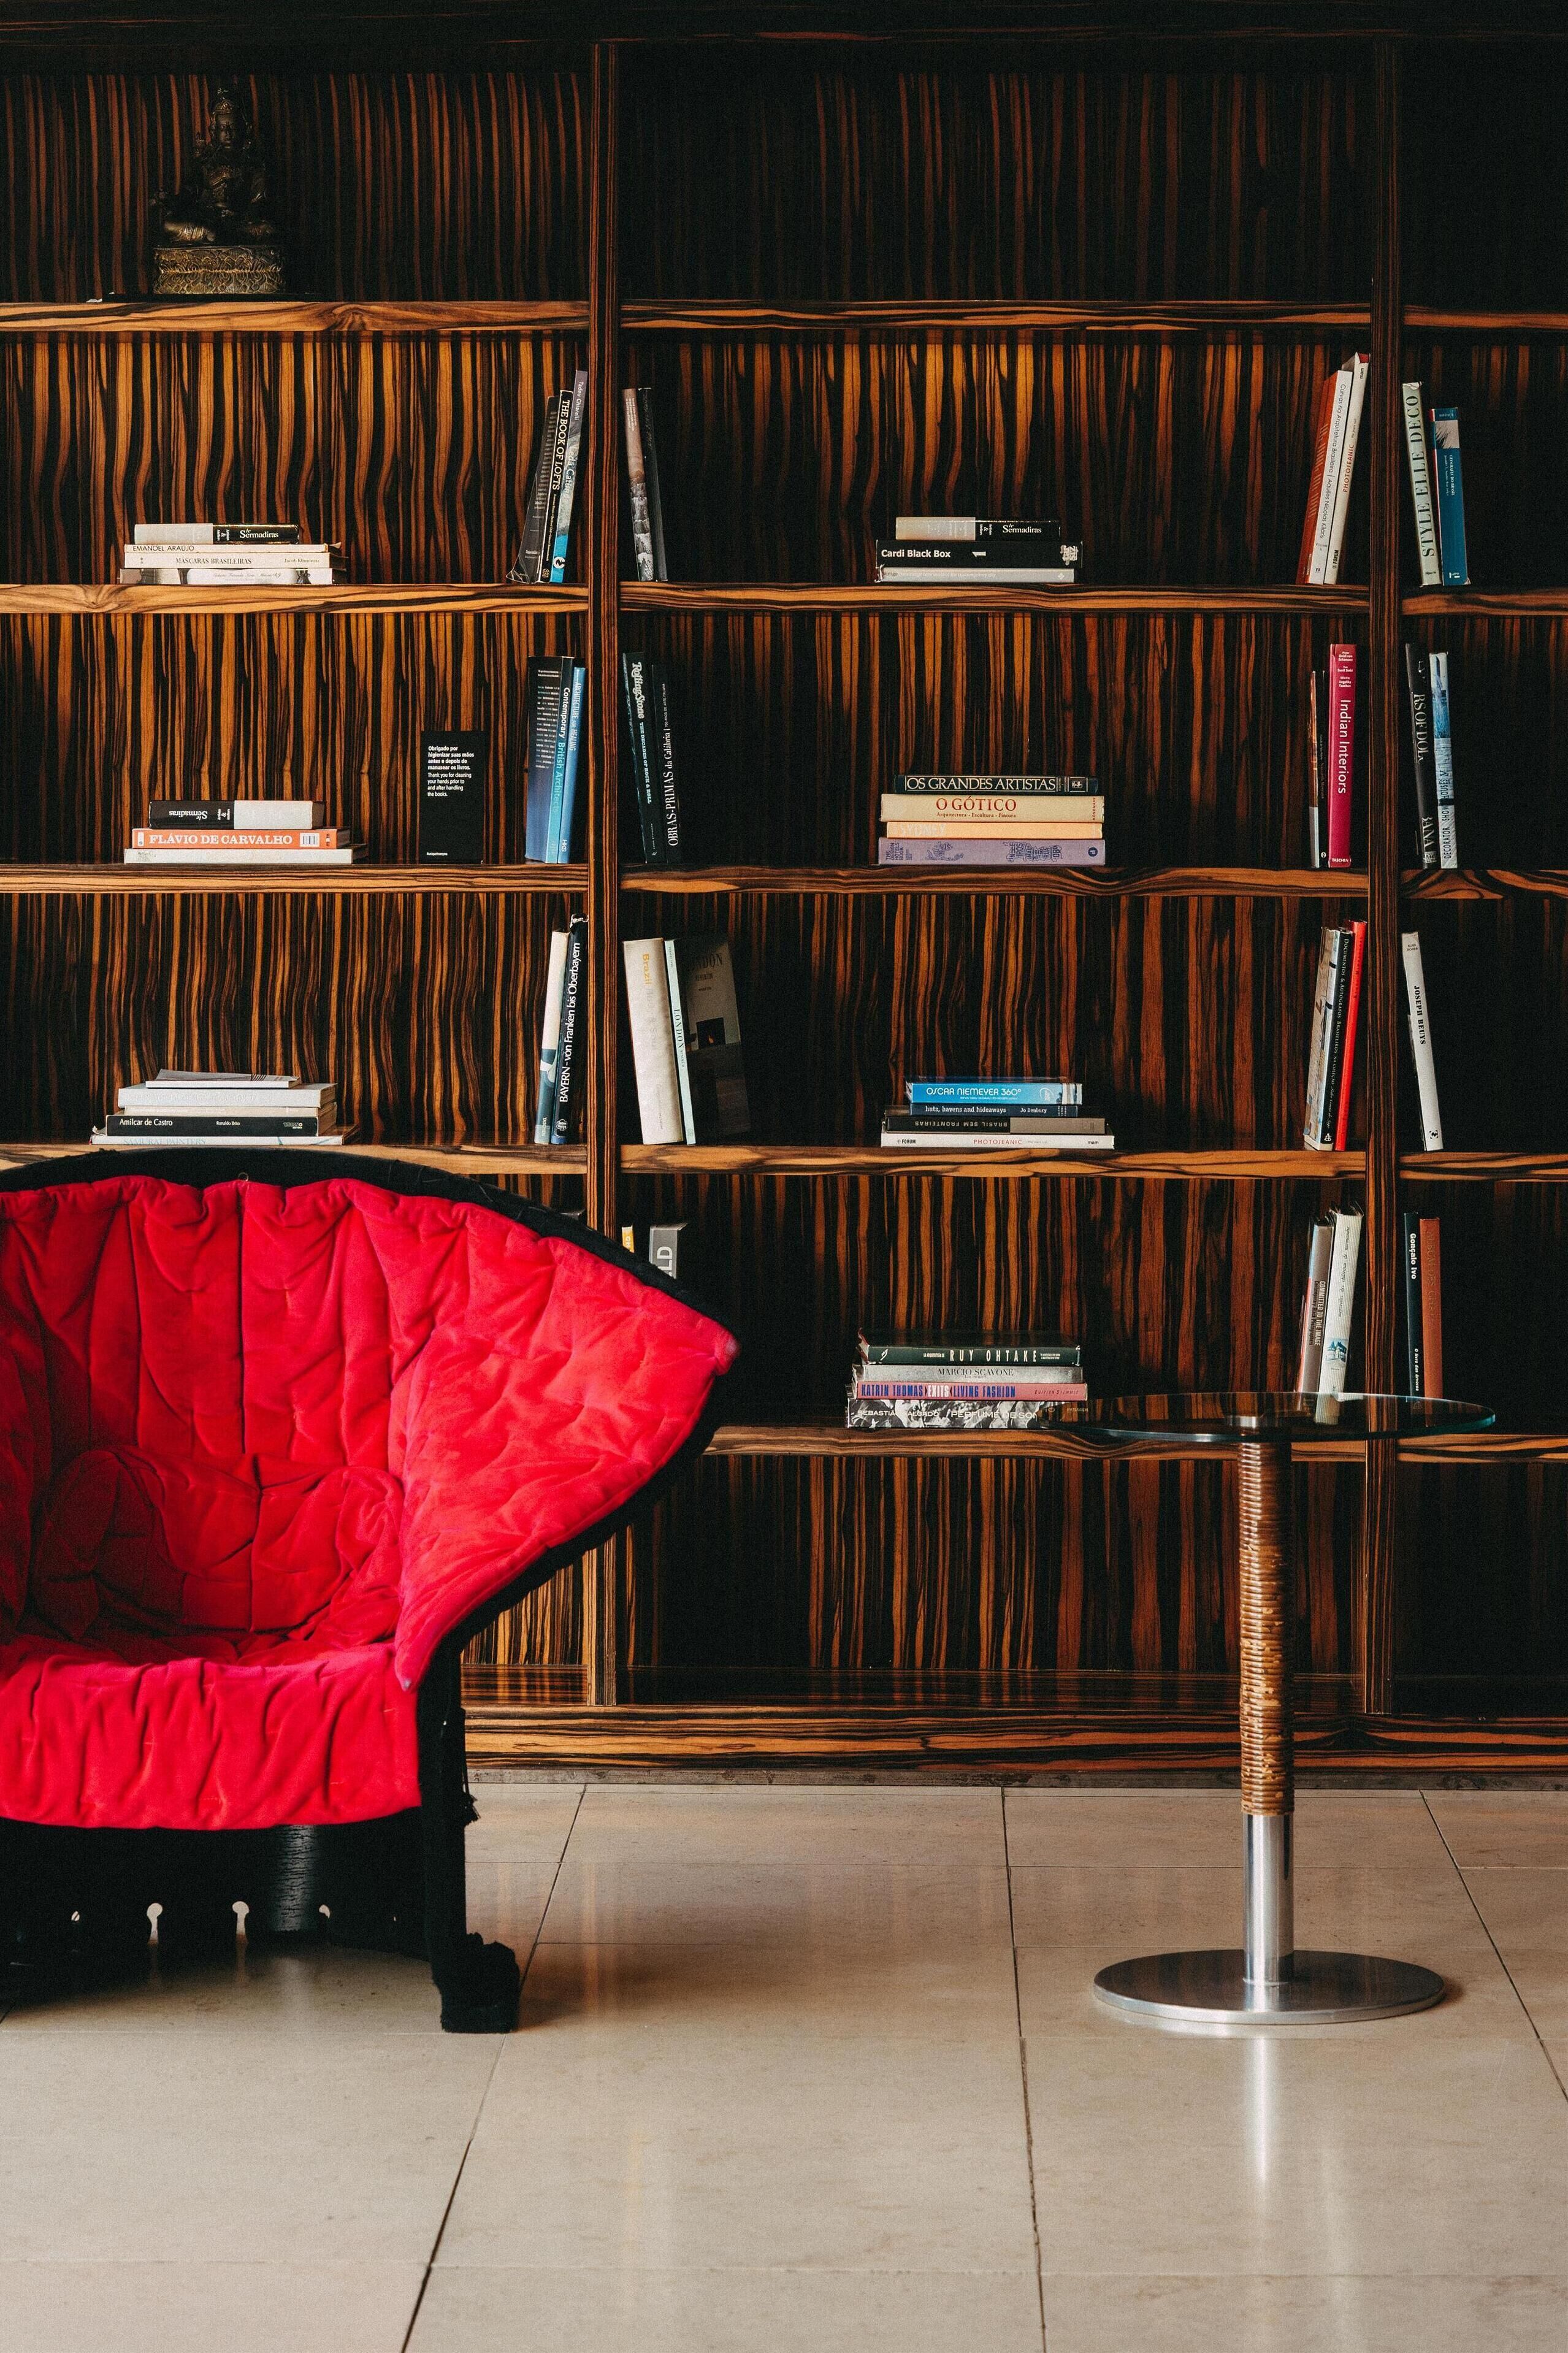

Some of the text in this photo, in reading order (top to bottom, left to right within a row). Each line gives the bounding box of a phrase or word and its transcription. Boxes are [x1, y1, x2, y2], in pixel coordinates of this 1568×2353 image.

[1337, 384, 1346, 404] Curvas
[1337, 404, 1342, 413] na
[1331, 415, 1342, 447] Arquitetura
[1405, 396, 1423, 443] DECO
[552, 400, 570, 491] THE BOOK OF LOFTS
[1329, 448, 1337, 473] Brasileira
[1343, 444, 1355, 492] PHOTOJEANIC
[1412, 451, 1429, 496] ELLE
[240, 529, 279, 538] Sermadiras
[1002, 524, 1042, 533] Sermadiras
[1417, 503, 1435, 557] STYLE
[559, 687, 570, 739] Contemporary
[569, 683, 582, 751] ARCHITECTURE HEALING
[1415, 711, 1428, 729] OF
[556, 742, 565, 768] British
[663, 732, 672, 760] Calábria
[1337, 700, 1352, 794] Indian Interiors
[665, 760, 673, 769] da
[907, 778, 926, 789] OS
[928, 778, 992, 790] GRANDES
[995, 778, 1056, 790] ARTISTAS
[1441, 779, 1450, 798] HOUSES
[169, 810, 208, 819] Sermadiras
[663, 771, 679, 846] OBRAS-PRIMAS
[936, 796, 1017, 811] O GÓTICO
[149, 833, 293, 844] FLÁVIO DE CARVALHO
[1442, 827, 1451, 859] DECORATOR
[568, 943, 582, 995] Oberbayern
[643, 954, 652, 985] Brazil
[566, 995, 576, 1009] bis
[1413, 985, 1423, 1016] JOSEPH
[564, 1009, 575, 1043] Franken
[673, 1009, 684, 1049] LONDON
[559, 1066, 570, 1103] BAYERN
[1317, 1281, 1326, 1311] COMMITTED
[950, 1350, 974, 1362] RUY
[986, 1350, 1037, 1362] OHTAKE
[862, 1384, 889, 1396] KATRIN
[892, 1385, 923, 1396] THOMAS
[928, 1385, 949, 1398] EXITS
[954, 1385, 979, 1398] LIVING
[983, 1386, 1015, 1398] FASHION
